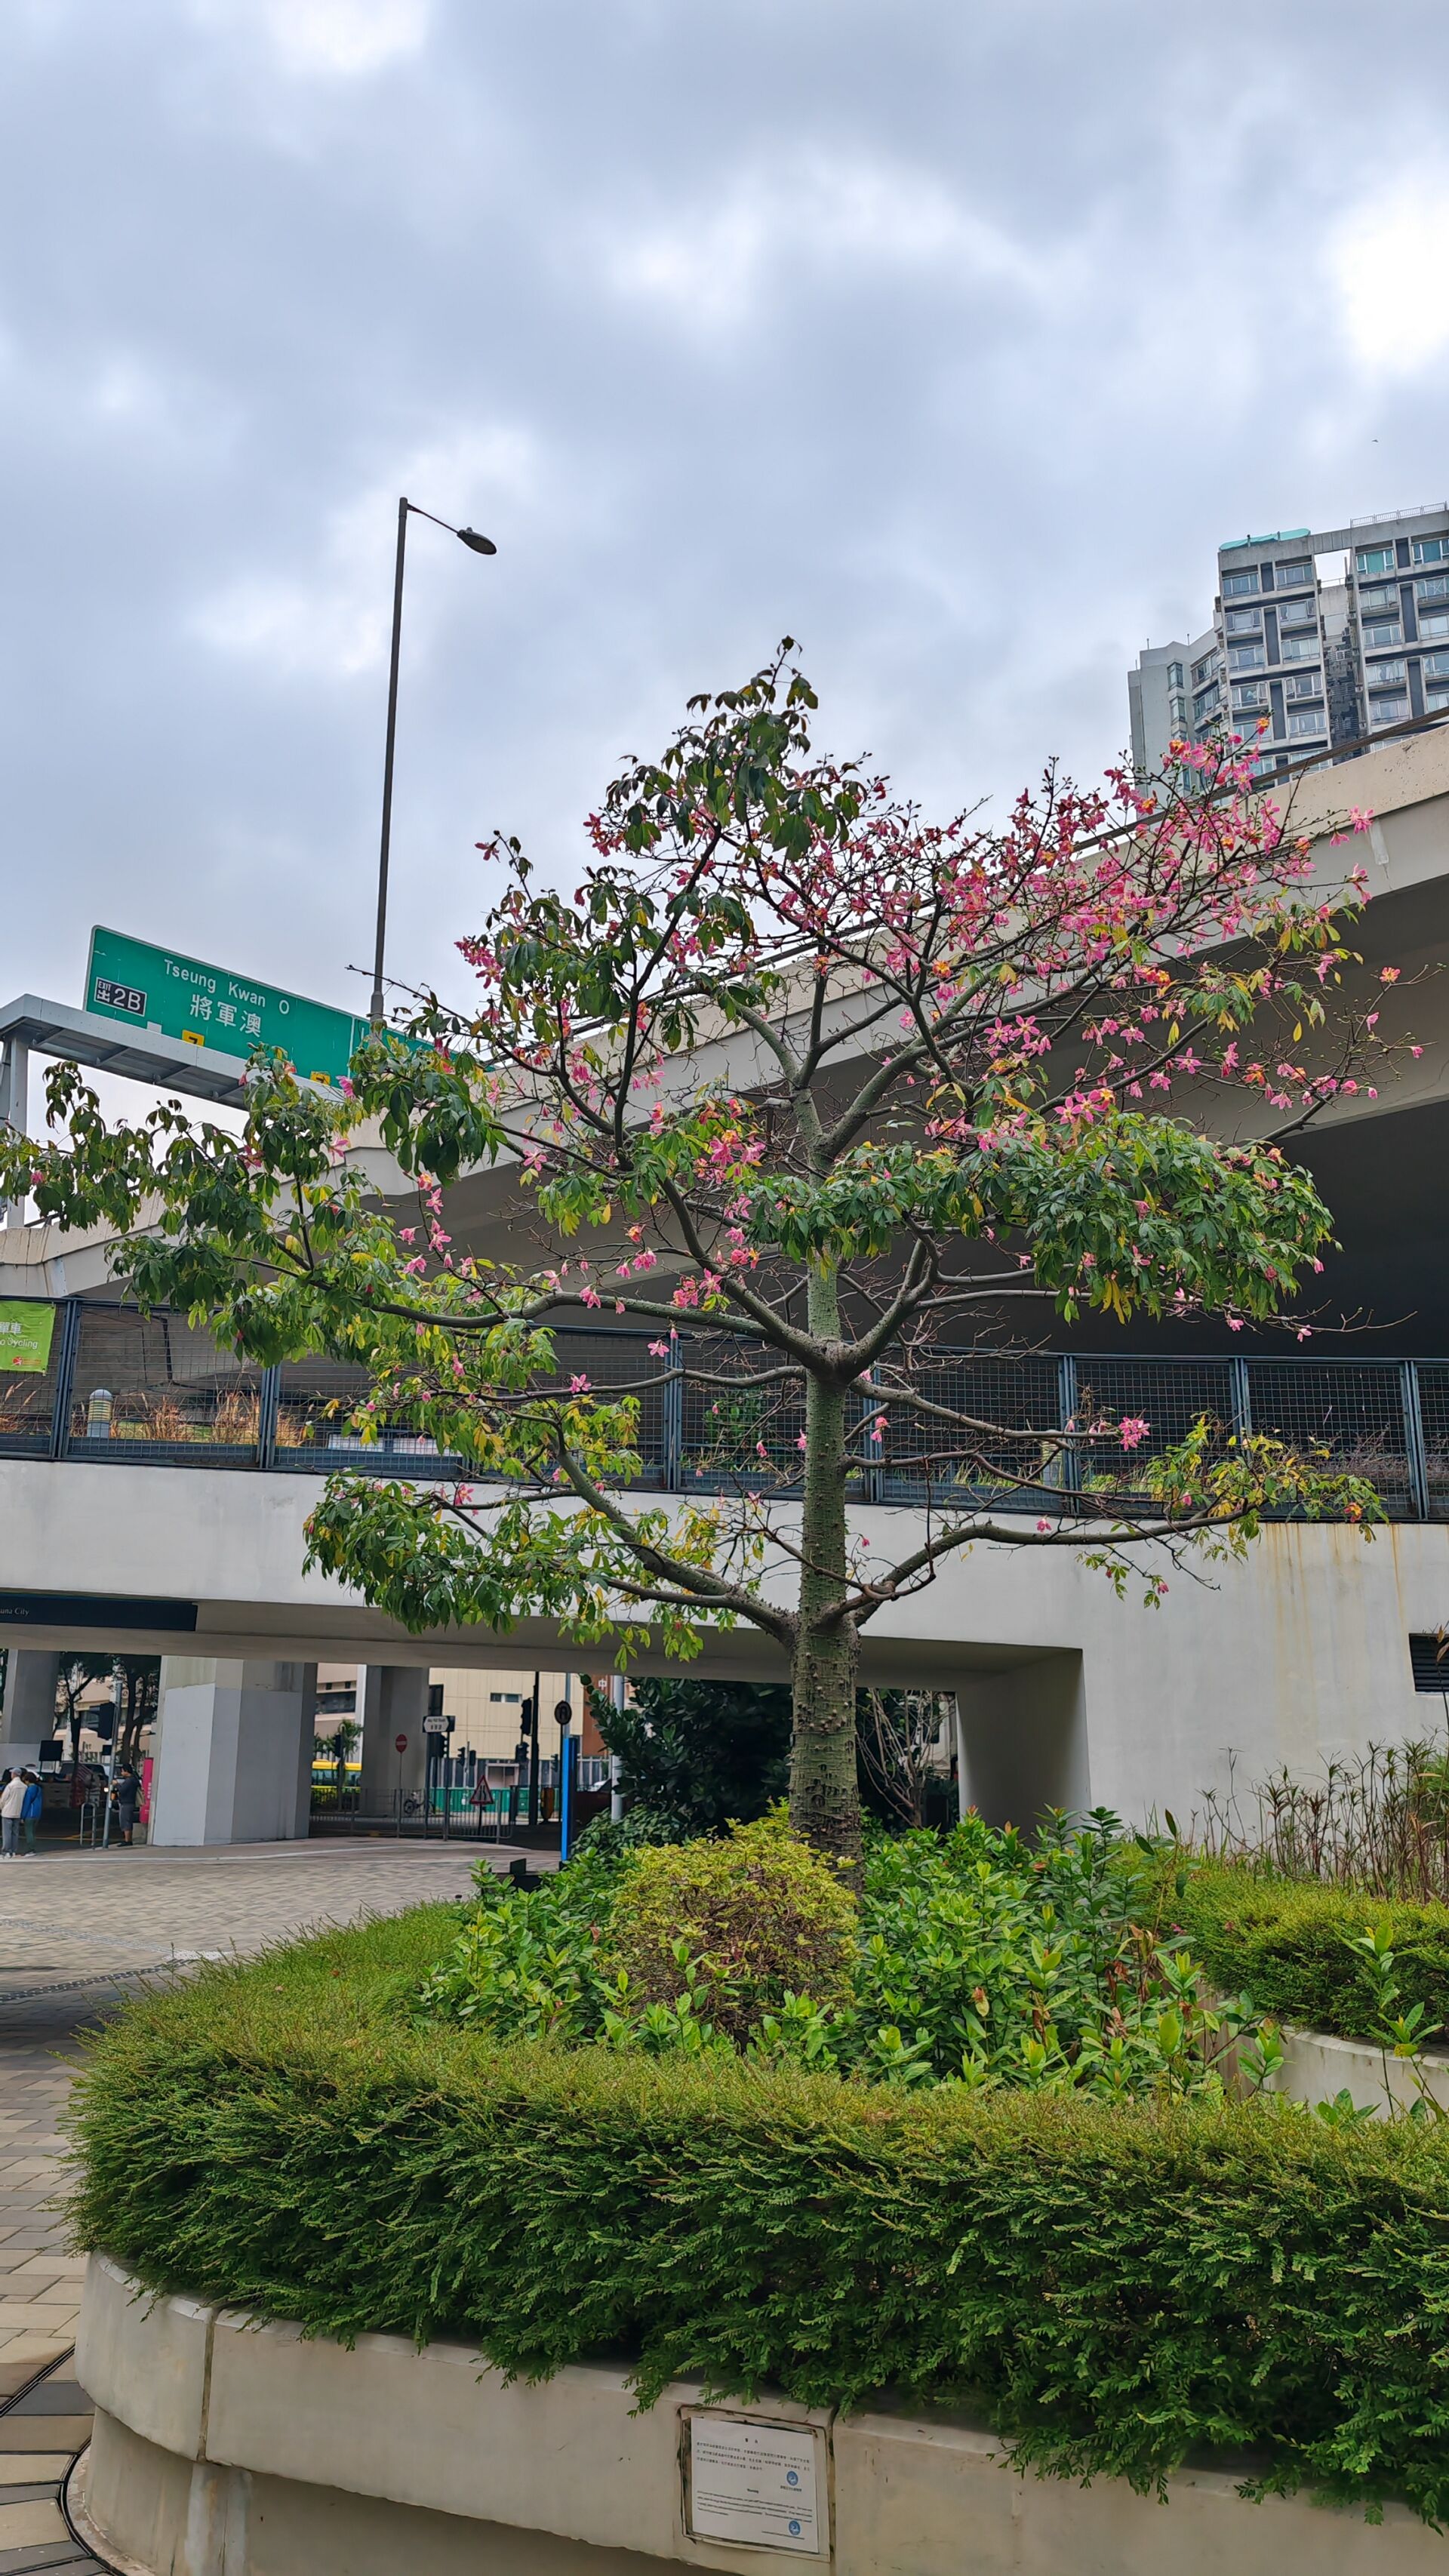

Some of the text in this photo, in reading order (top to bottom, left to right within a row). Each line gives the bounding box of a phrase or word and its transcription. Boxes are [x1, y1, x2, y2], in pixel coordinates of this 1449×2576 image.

[98, 980, 112, 991] EXIT
[164, 959, 290, 1015] Tseung Kwan O
[97, 989, 110, 1002] 出
[113, 988, 141, 1011] 2B
[189, 993, 262, 1038] 將軍澳
[7, 1337, 38, 1350] Cycling
[14, 1607, 29, 1617] City
